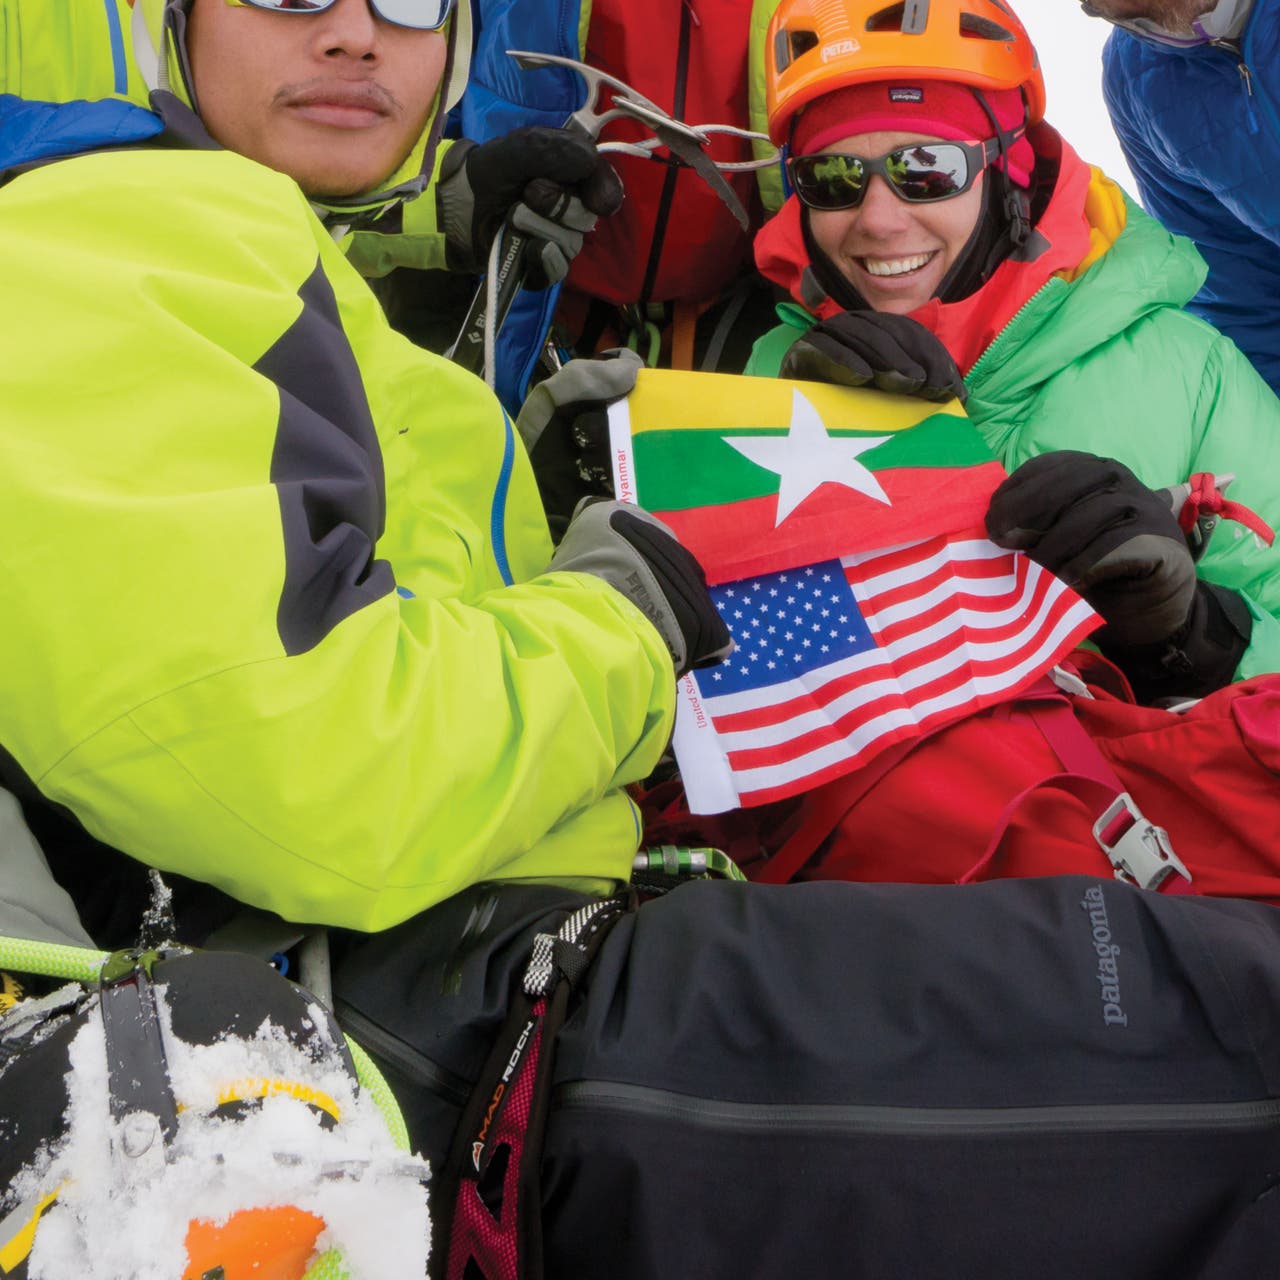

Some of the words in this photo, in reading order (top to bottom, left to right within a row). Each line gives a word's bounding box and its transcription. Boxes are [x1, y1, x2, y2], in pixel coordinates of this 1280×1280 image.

[822, 40, 861, 64] PETZL
[688, 697, 708, 728] United
[1081, 884, 1128, 1028] patagonia
[478, 1083, 505, 1141] MAD
[502, 1021, 534, 1082] ROCK
